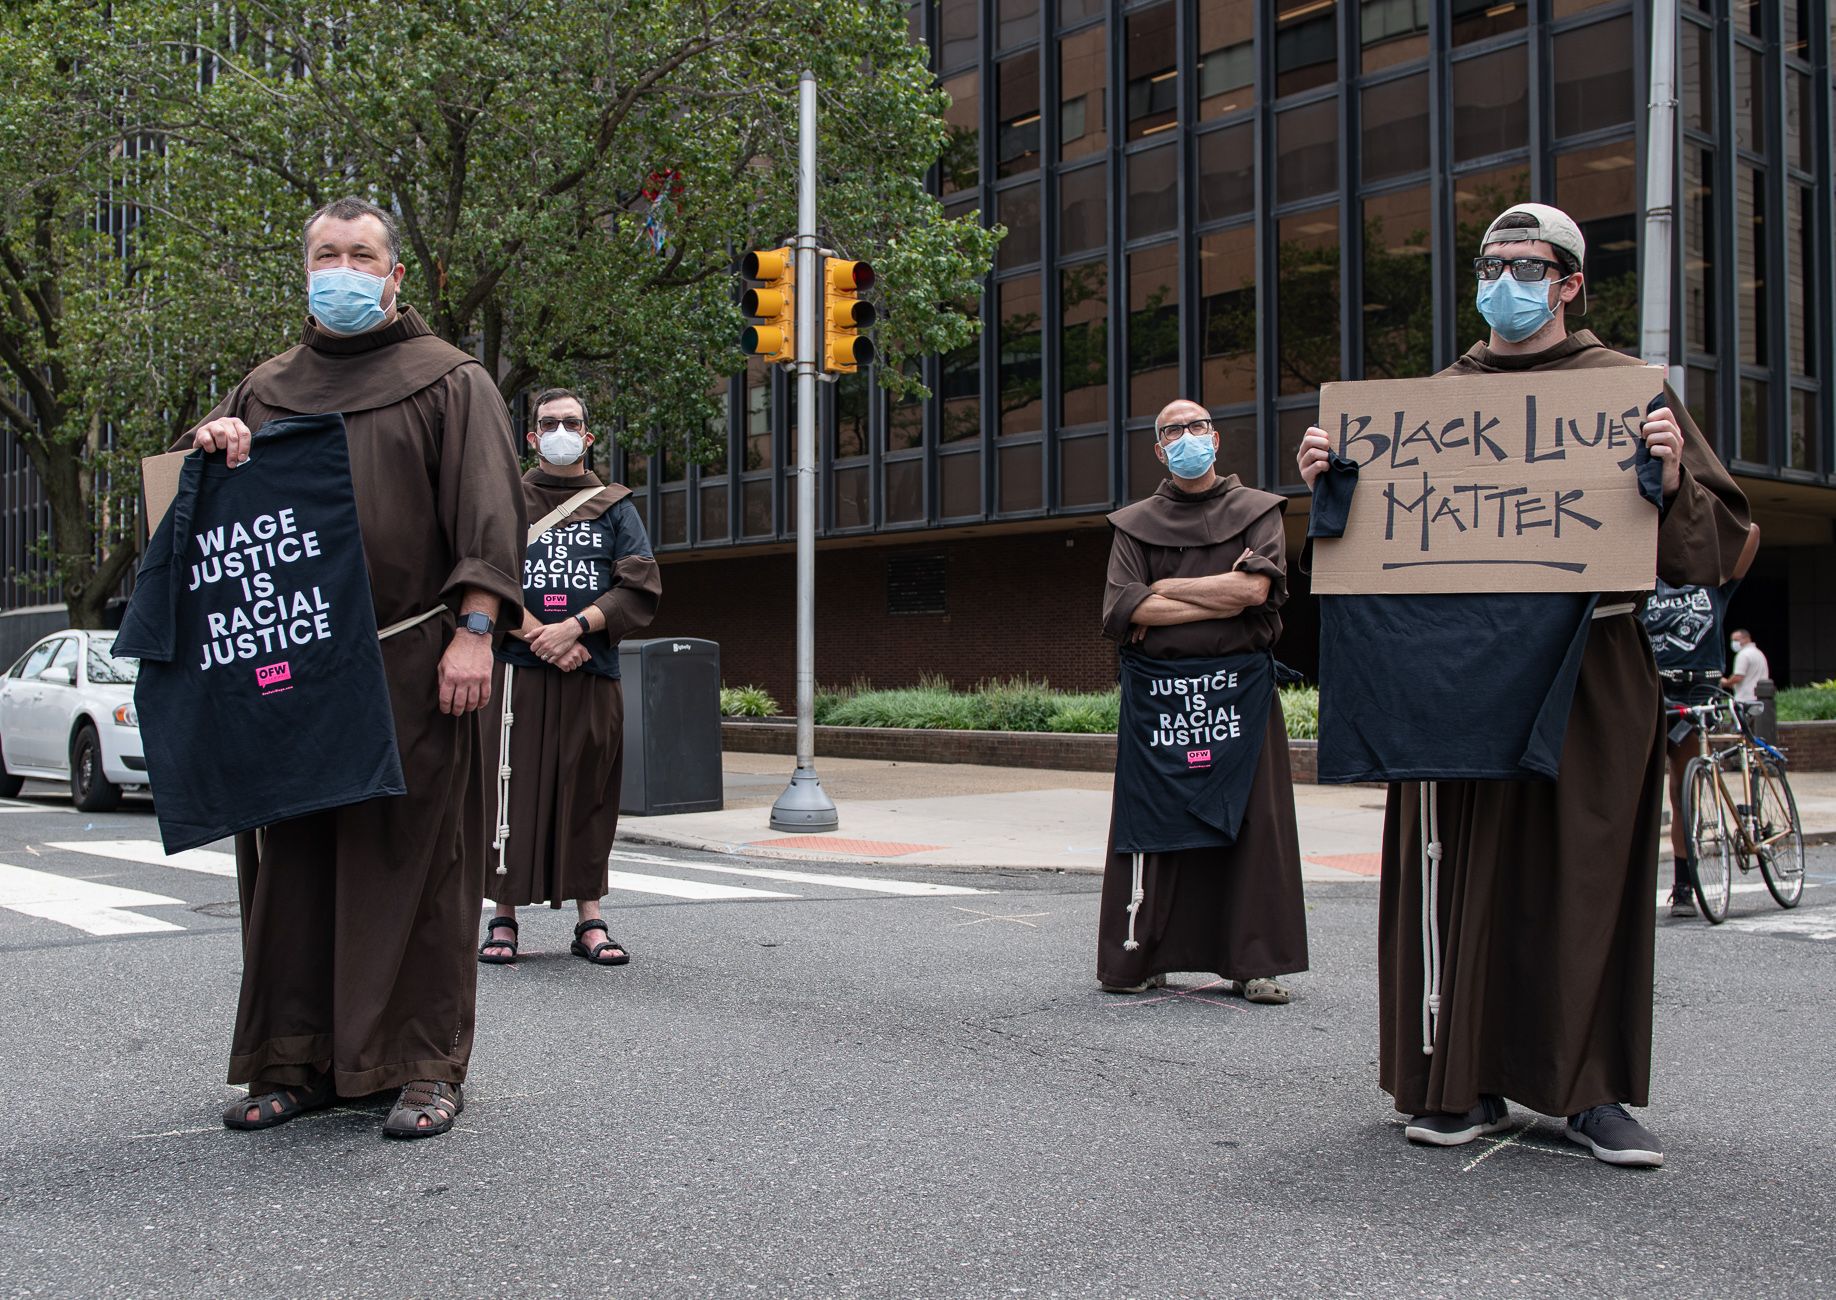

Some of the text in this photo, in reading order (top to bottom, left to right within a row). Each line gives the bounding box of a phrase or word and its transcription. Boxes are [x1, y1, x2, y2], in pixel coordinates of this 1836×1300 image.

[1338, 411, 1508, 469] BLACK
[1382, 471, 1603, 551] MATTER
[196, 507, 297, 557] WAGE
[527, 531, 602, 548] STICE
[188, 530, 322, 591] JUSTICE
[547, 545, 568, 559] IS
[524, 559, 599, 575] RACIAL
[240, 572, 275, 602] IS
[522, 573, 599, 591] USTICE
[207, 586, 330, 639] RACIAL
[200, 612, 332, 671] JUSTICE
[259, 664, 286, 679] OFW
[1149, 671, 1238, 696] JUSTICE
[1184, 694, 1207, 712] IS
[1159, 705, 1241, 729] RACIAL
[1150, 721, 1241, 747] JUSTICE
